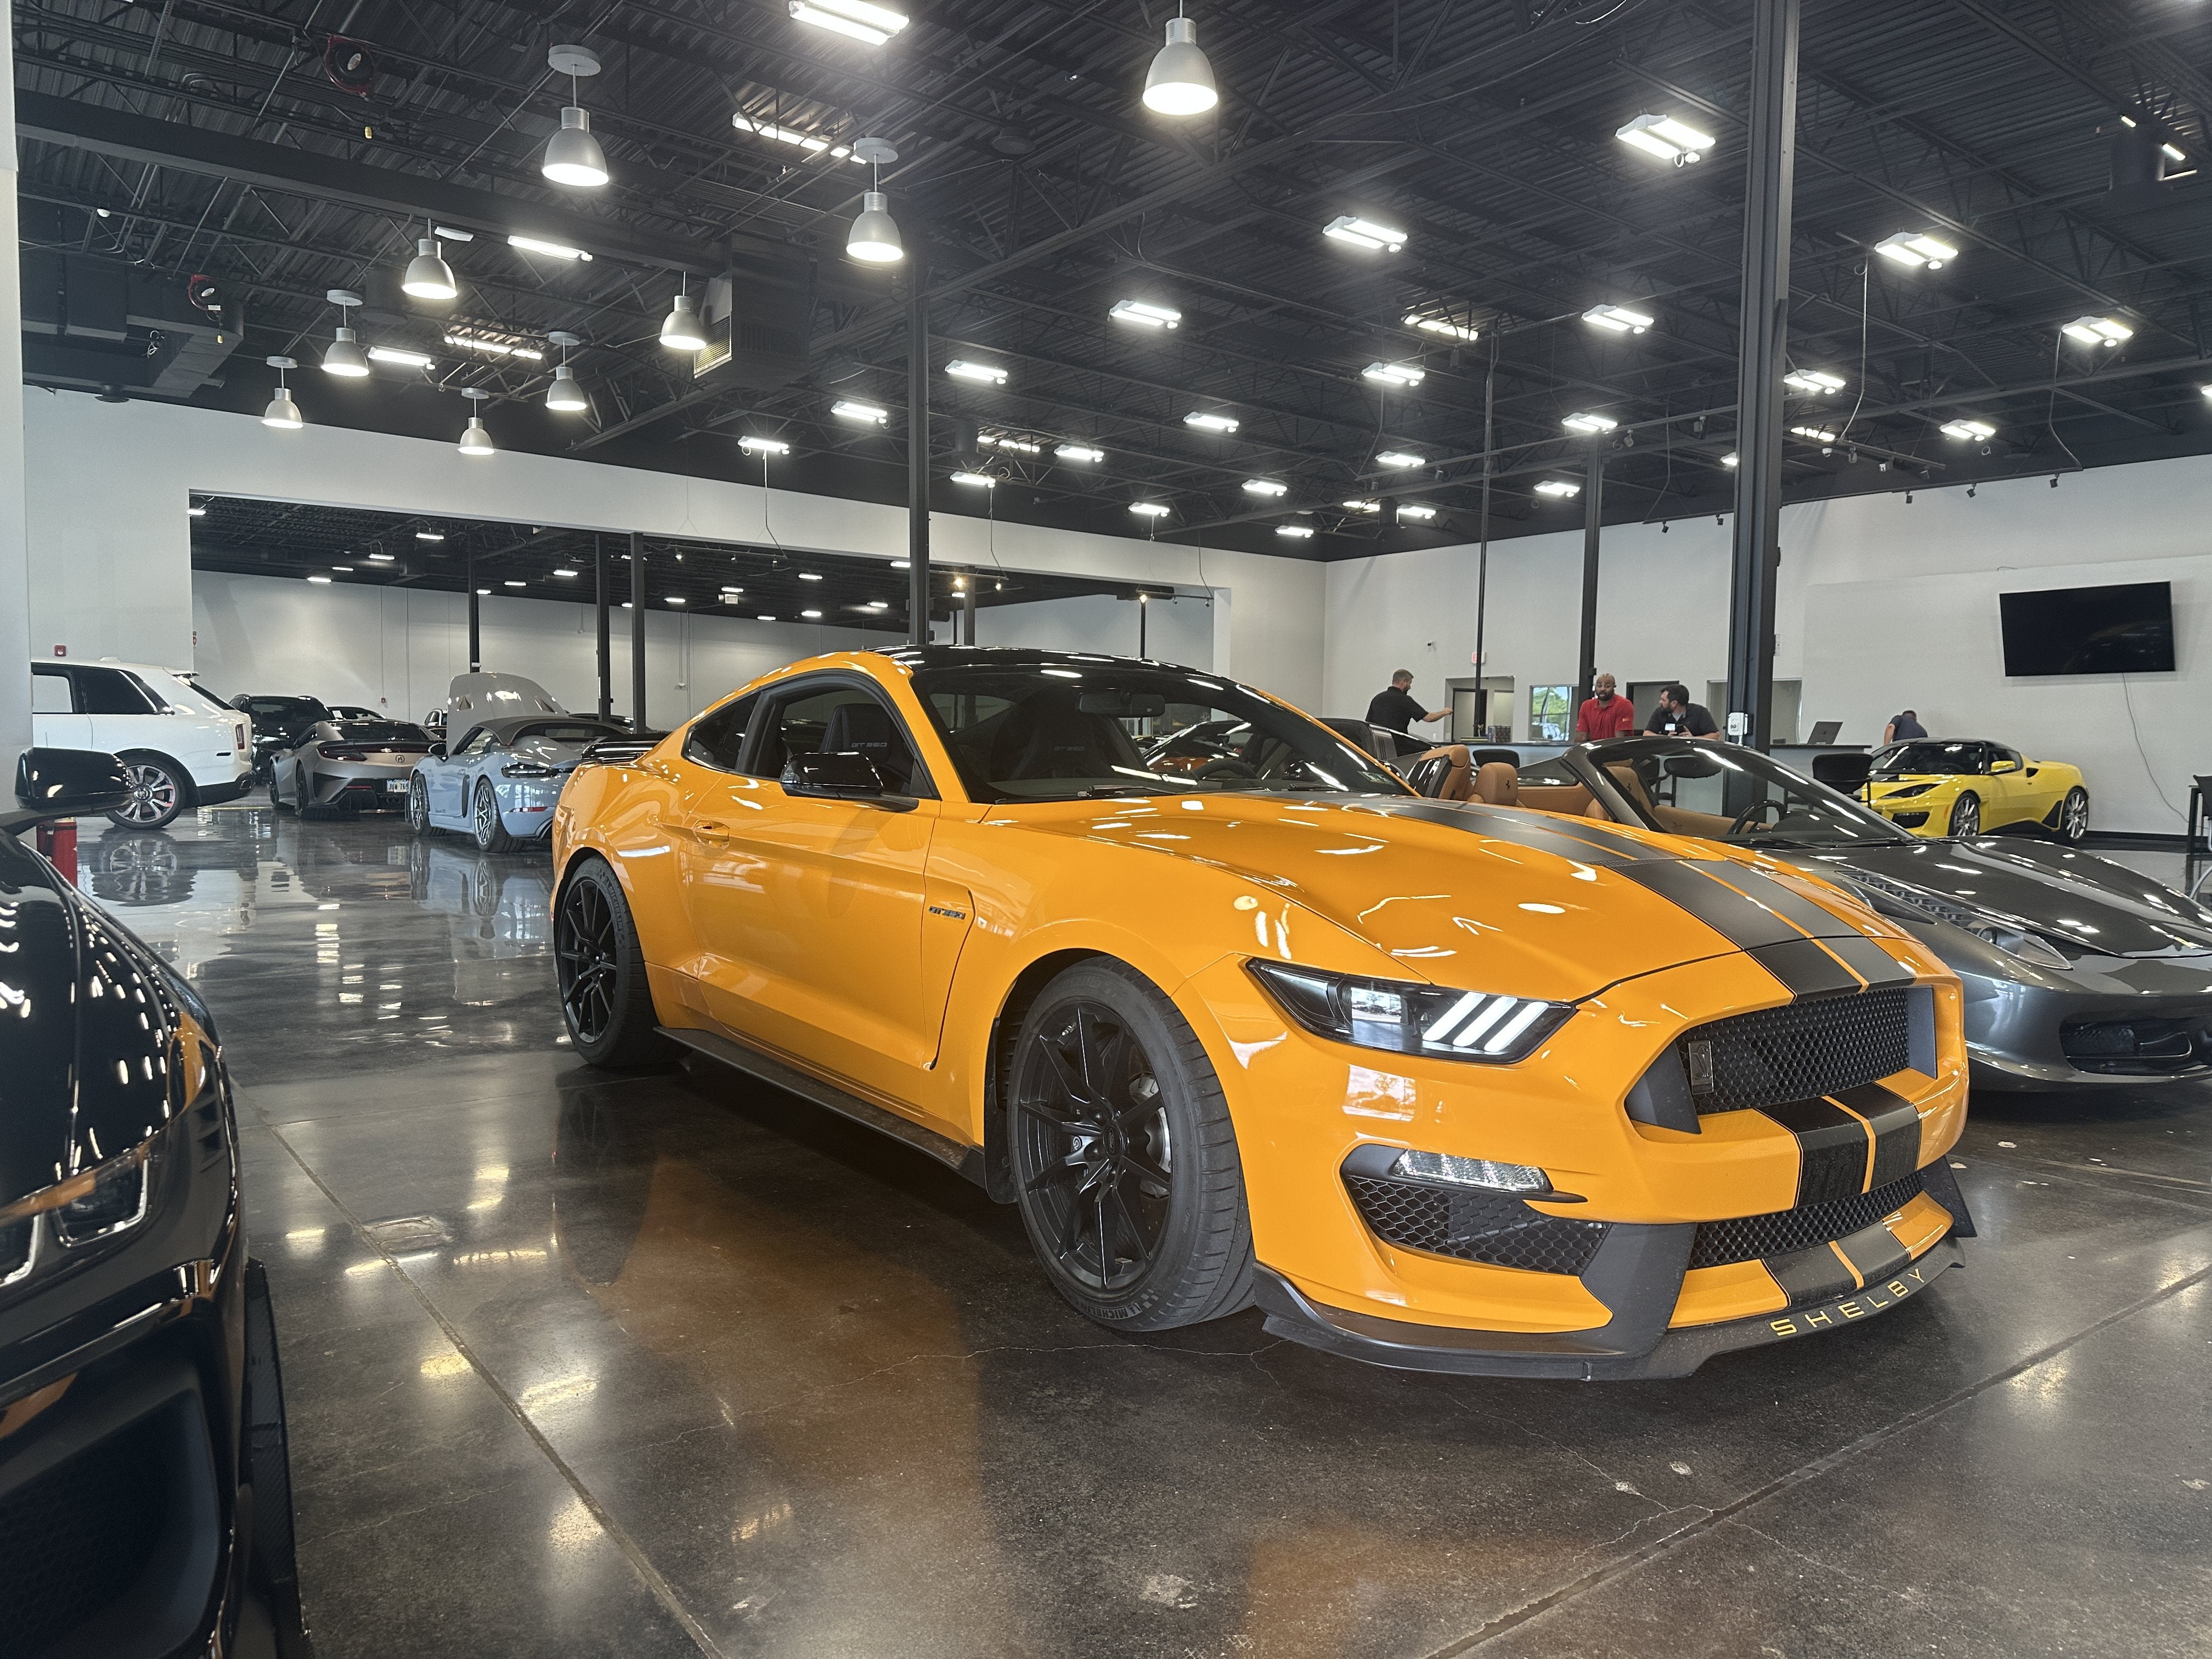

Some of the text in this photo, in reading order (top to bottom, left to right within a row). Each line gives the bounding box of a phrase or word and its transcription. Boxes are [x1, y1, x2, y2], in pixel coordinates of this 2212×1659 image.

[608, 885, 624, 931] MICHELIN
[1080, 1302, 1129, 1318] MICHELIN
[1770, 1268, 1925, 1336] SHELBY
